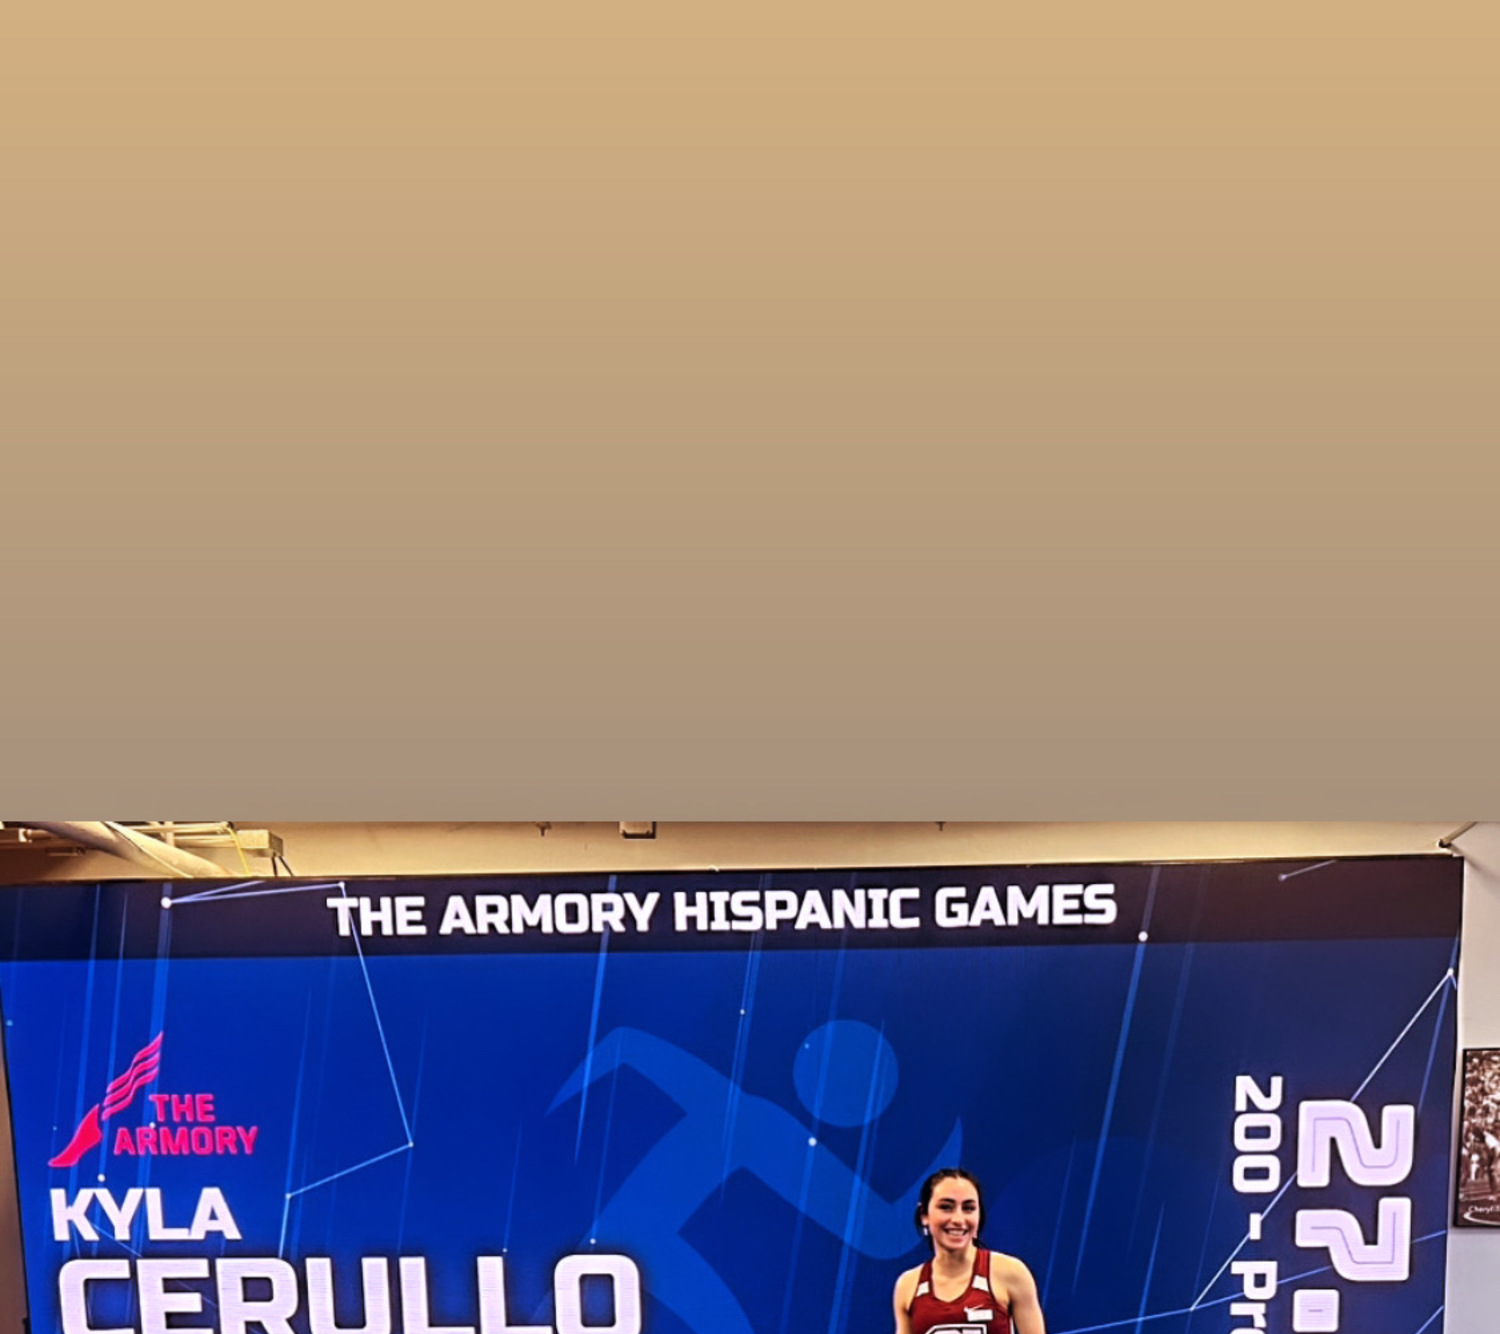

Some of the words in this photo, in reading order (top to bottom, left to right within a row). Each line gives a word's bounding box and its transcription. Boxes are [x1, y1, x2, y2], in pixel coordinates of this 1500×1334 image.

[326, 896, 427, 937] THE
[439, 892, 660, 935] ARMORY
[674, 887, 921, 932] HISPANIC
[935, 883, 1118, 928] GAMES
[148, 1093, 216, 1122] THE
[1232, 1075, 1283, 1193] 200
[113, 1125, 259, 1156] ARMORY
[50, 1186, 243, 1241] KYLA
